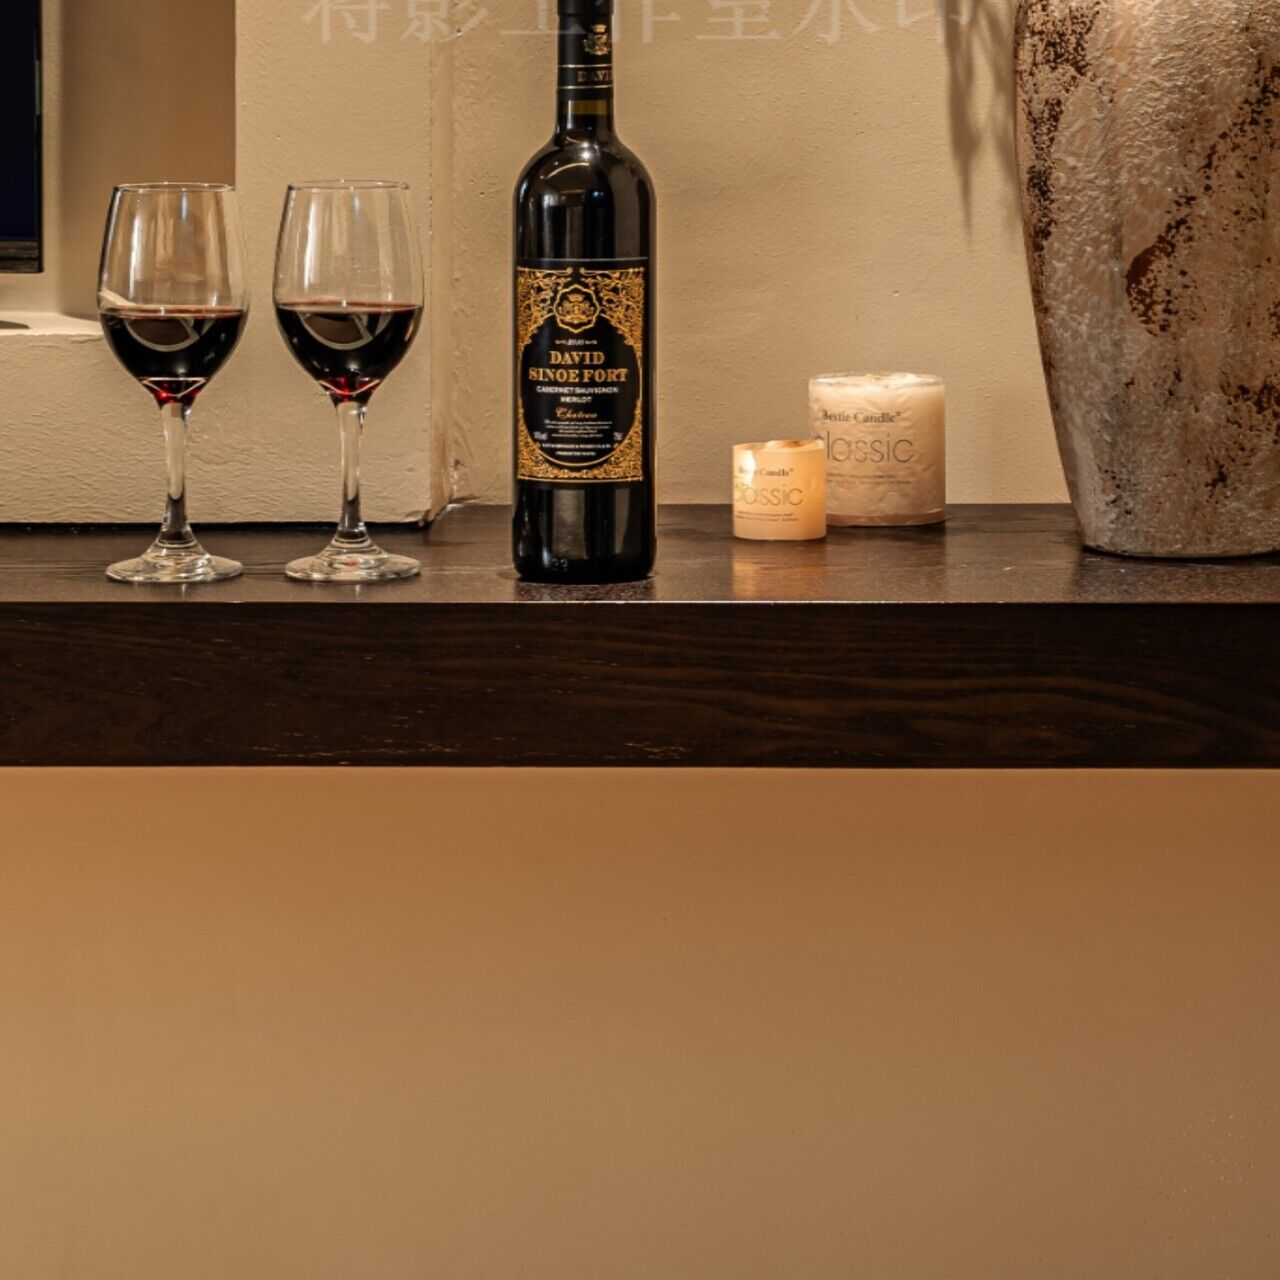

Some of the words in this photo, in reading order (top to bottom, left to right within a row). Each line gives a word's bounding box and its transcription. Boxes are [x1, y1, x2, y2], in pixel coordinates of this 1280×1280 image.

[549, 350, 605, 365] DAVID
[528, 367, 579, 382] SINOE
[582, 368, 628, 382] FORT
[814, 430, 915, 463] lassic
